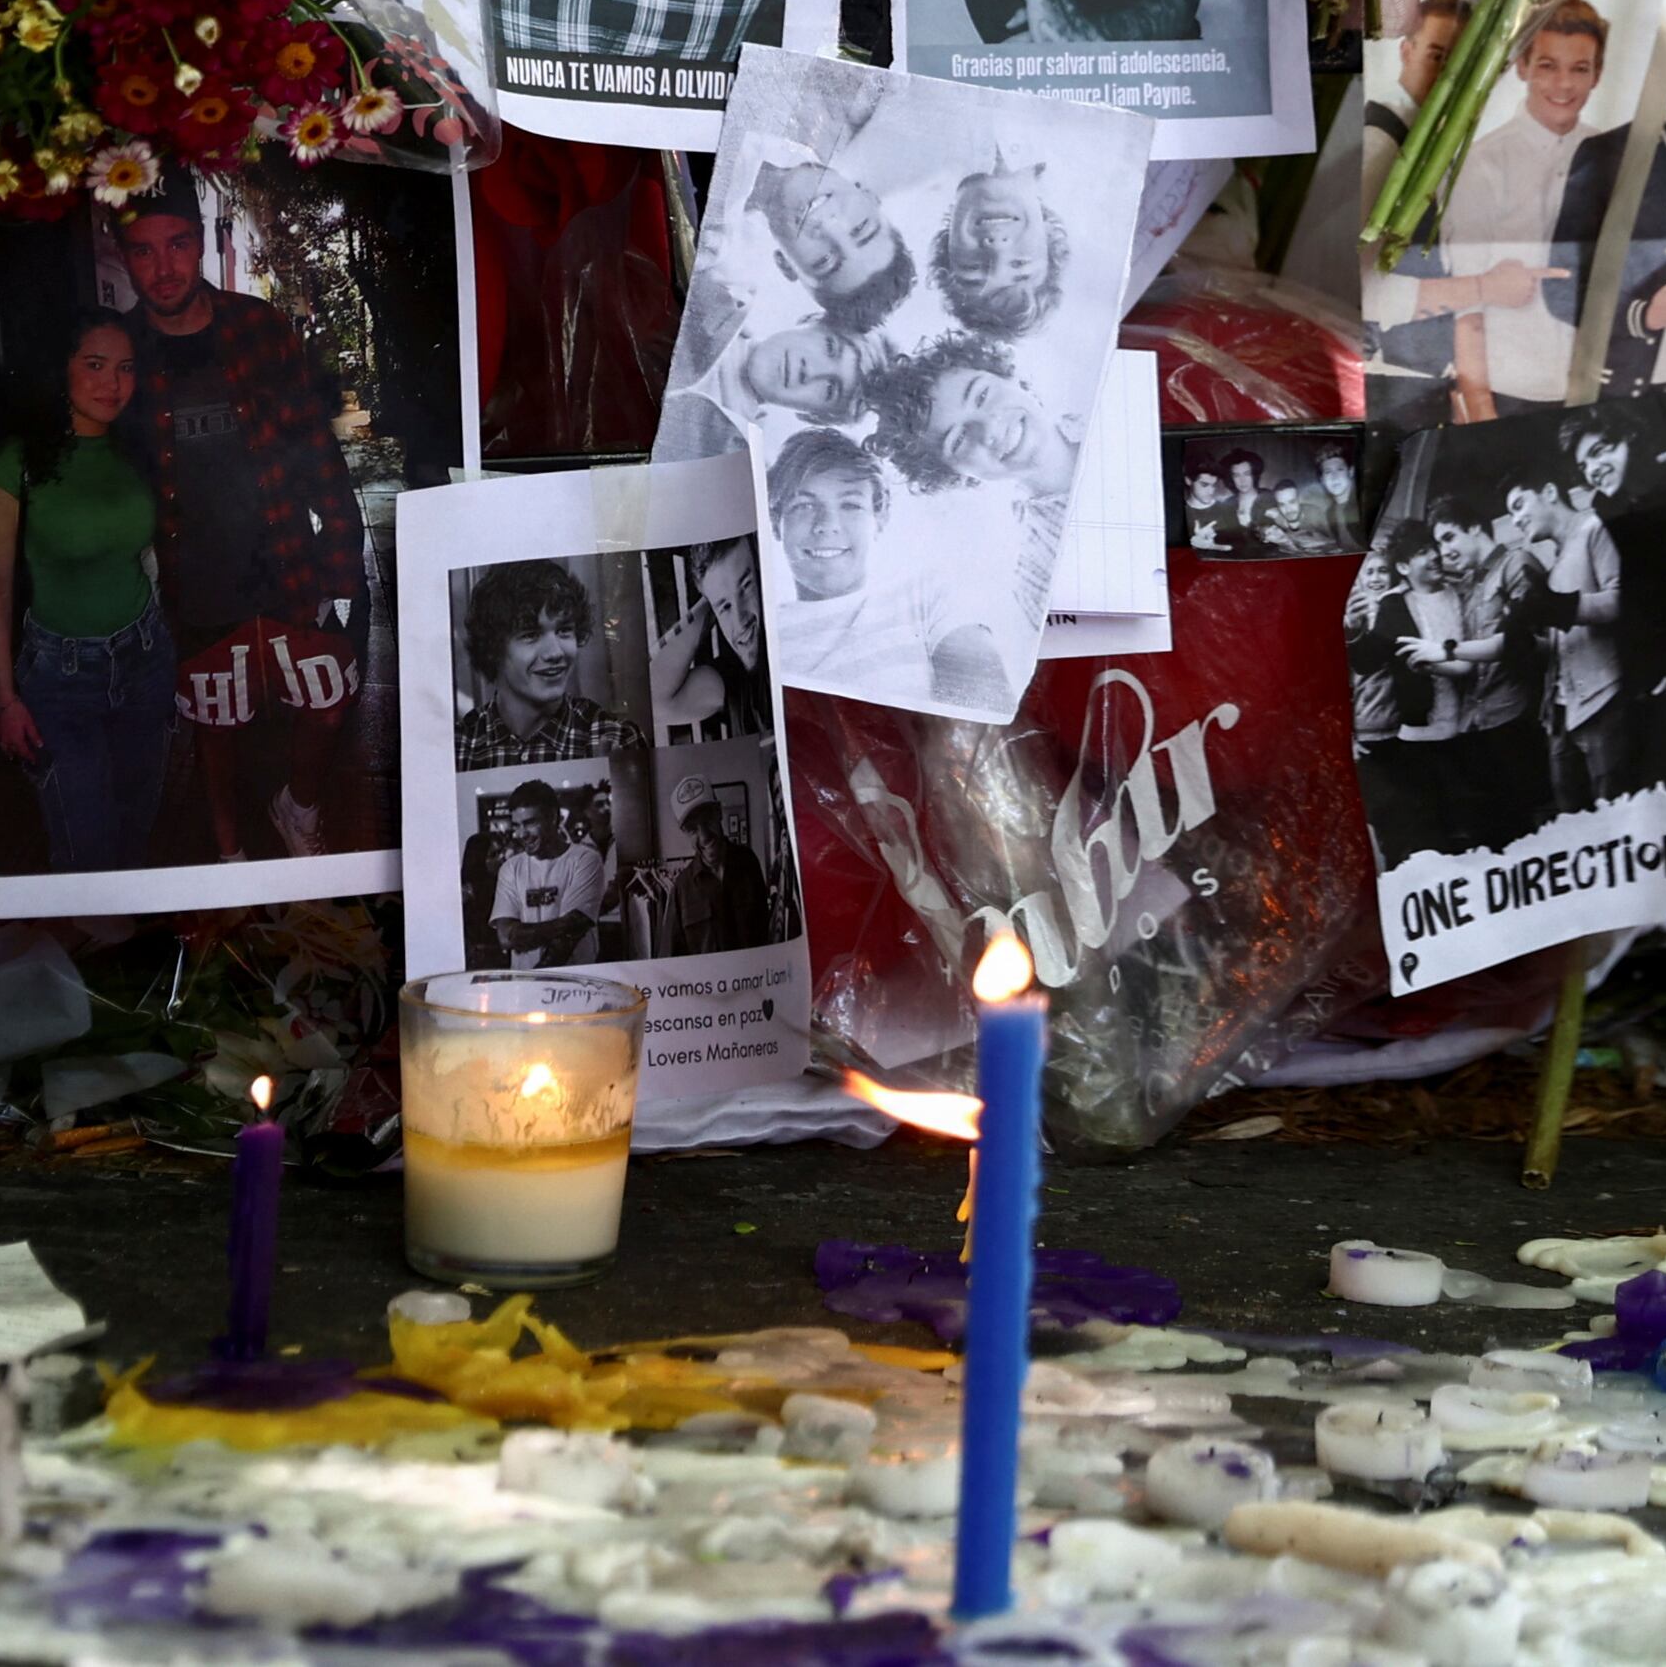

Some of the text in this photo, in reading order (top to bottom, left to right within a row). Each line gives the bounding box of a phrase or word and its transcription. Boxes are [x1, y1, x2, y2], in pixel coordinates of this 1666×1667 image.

[506, 55, 566, 91] NUNCA
[568, 61, 590, 92] TE
[592, 62, 656, 97] VAMOS
[659, 68, 673, 96] A
[951, 48, 1232, 80] Gracias por salvar mi adolescencia,
[1104, 83, 1140, 106] Liam
[1143, 82, 1197, 109] Payne.
[1401, 879, 1475, 941] ONE
[657, 981, 713, 1000] vamos
[716, 980, 728, 994] a
[732, 975, 764, 993] amar
[766, 970, 787, 989] Liam
[644, 1008, 763, 1034] escansa en paz
[648, 1039, 778, 1067] Lovers Mañaneras
